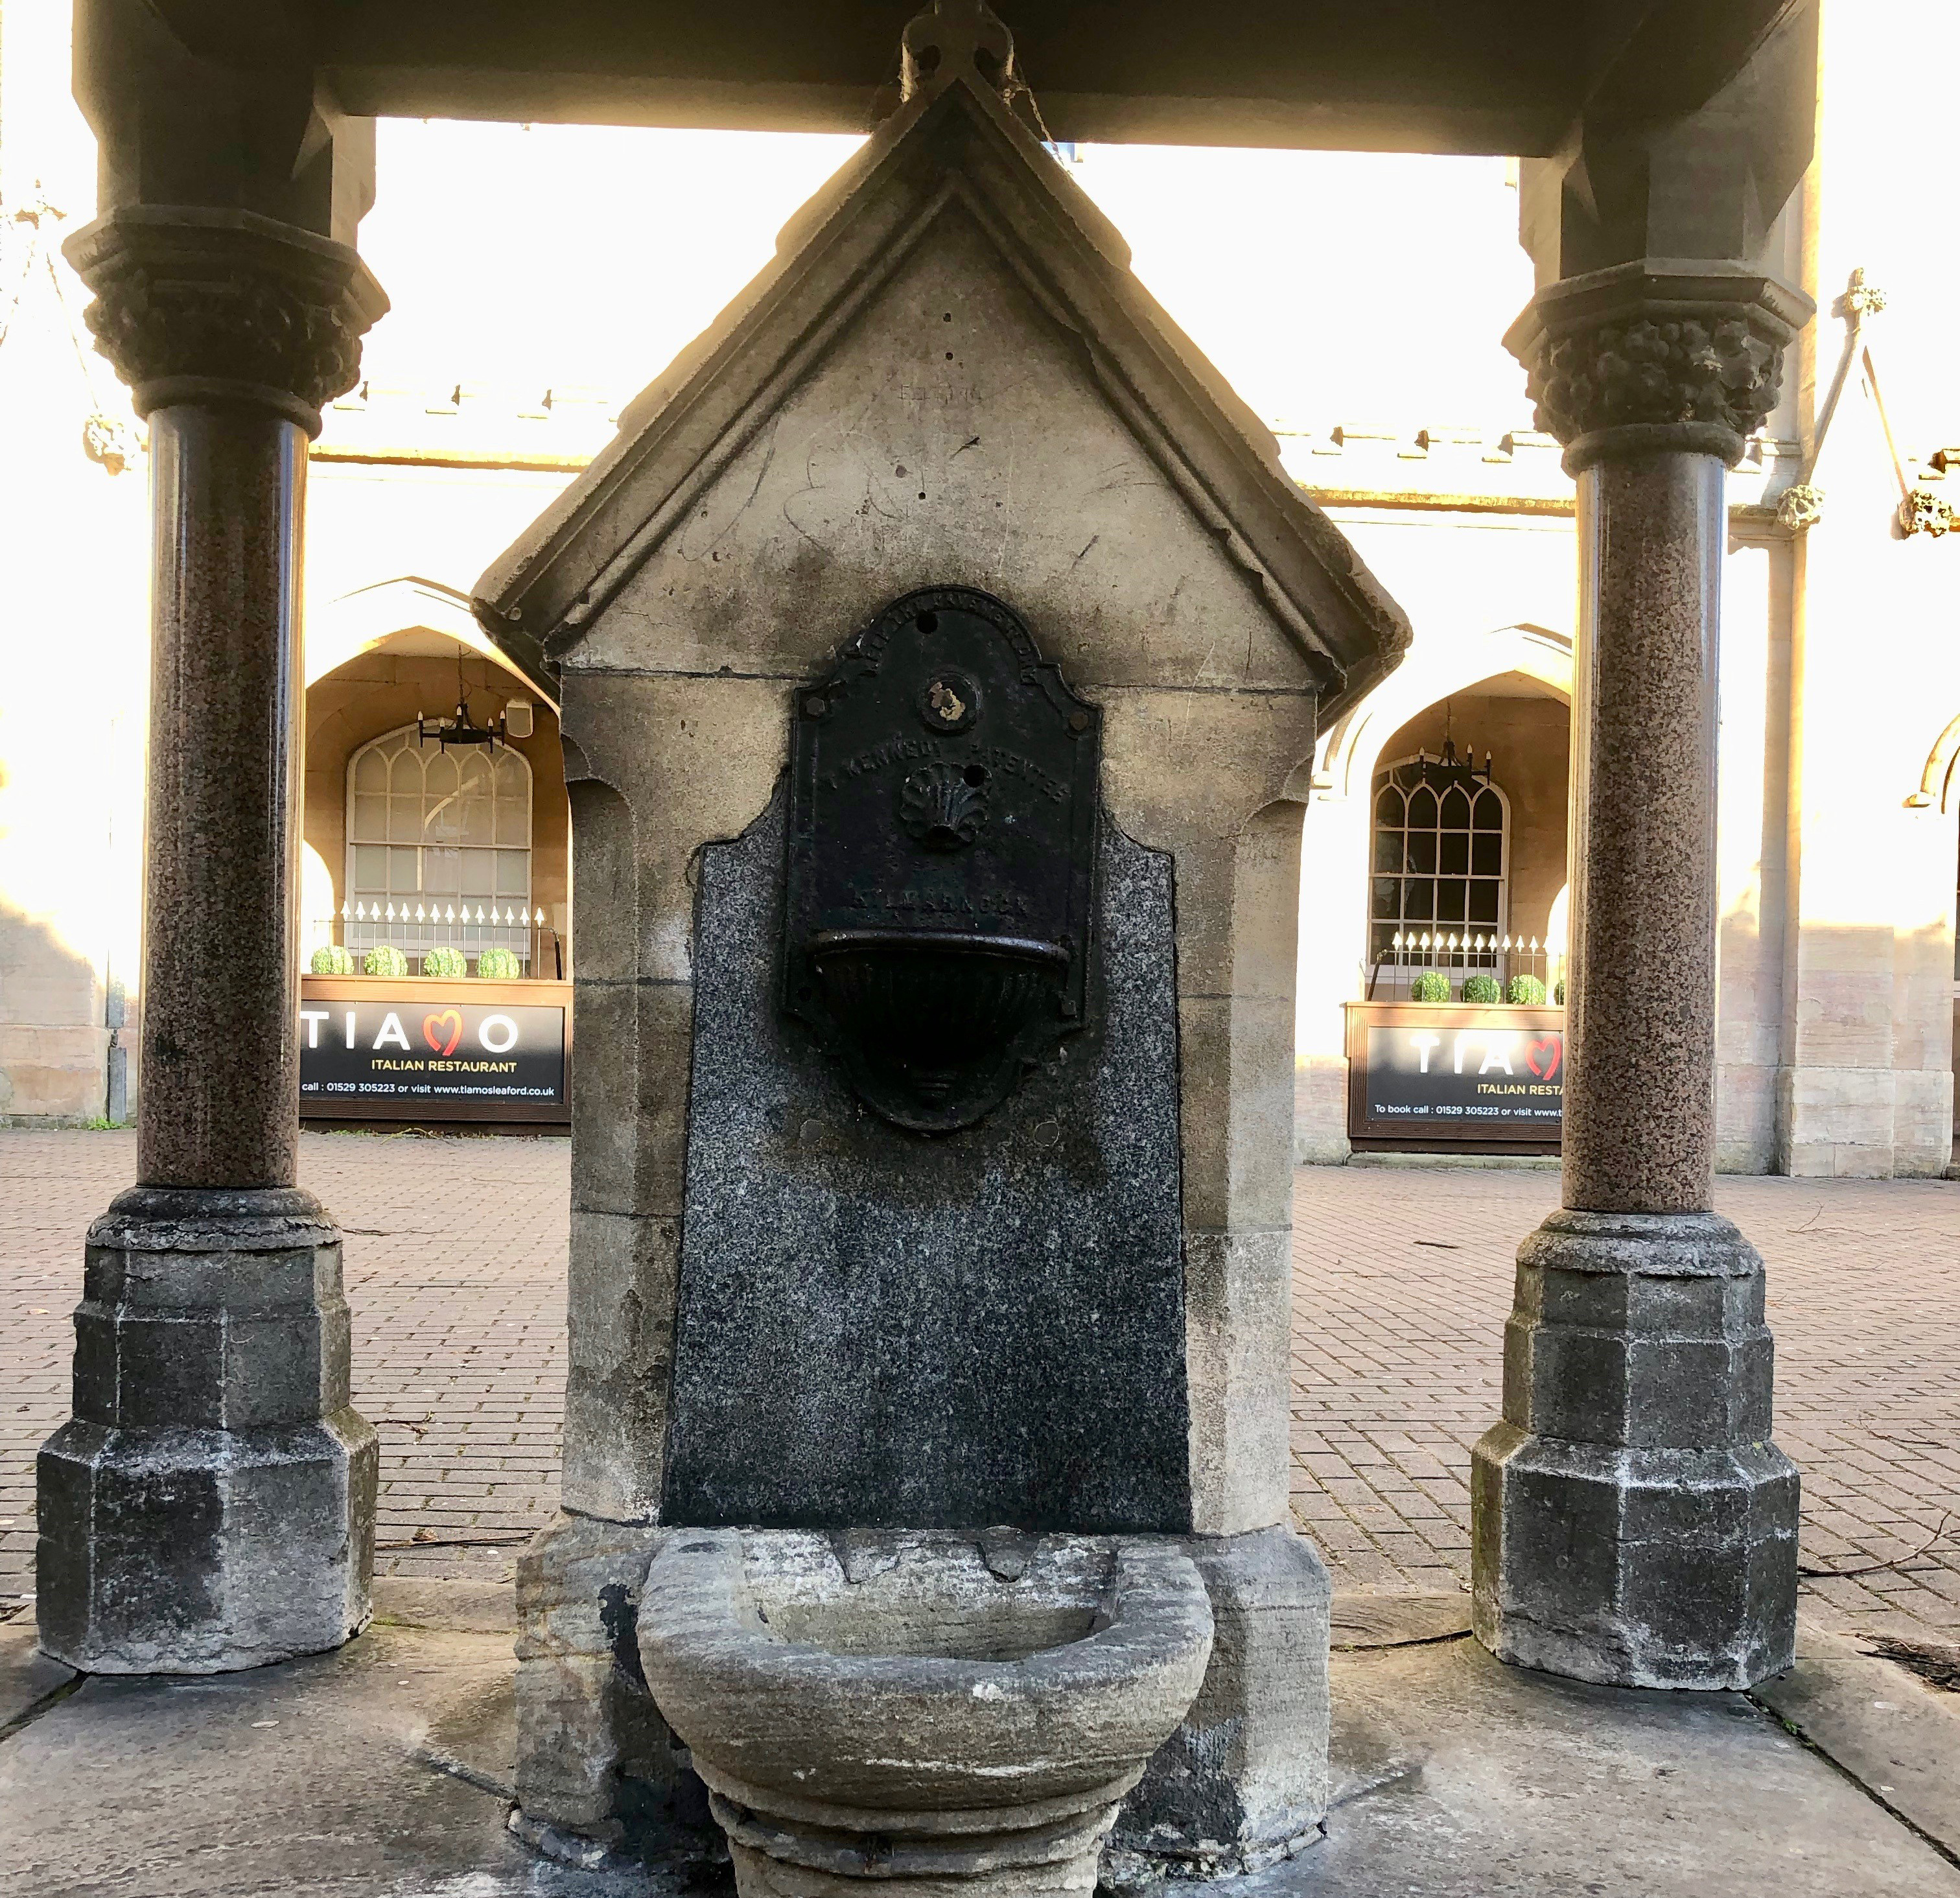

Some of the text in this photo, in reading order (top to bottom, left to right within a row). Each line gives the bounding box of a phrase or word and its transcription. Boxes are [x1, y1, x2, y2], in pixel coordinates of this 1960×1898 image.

[371, 1059, 517, 1073] ITALIAN RESTAURANT
[301, 1082, 319, 1092] call
[327, 1082, 356, 1092] 01529
[358, 1083, 395, 1093] 305223
[397, 1085, 409, 1094] or
[411, 1084, 431, 1094] visit
[434, 1085, 555, 1097] www.tiamosleaford.co.uk
[1477, 1083, 1526, 1095] ITALIAN
[1374, 1104, 1386, 1114] To
[1388, 1104, 1411, 1114] book
[1413, 1105, 1429, 1114] call
[1436, 1105, 1463, 1115] 01529
[1465, 1106, 1499, 1116] 305223
[1500, 1108, 1511, 1116] or
[1513, 1107, 1532, 1116] visit
